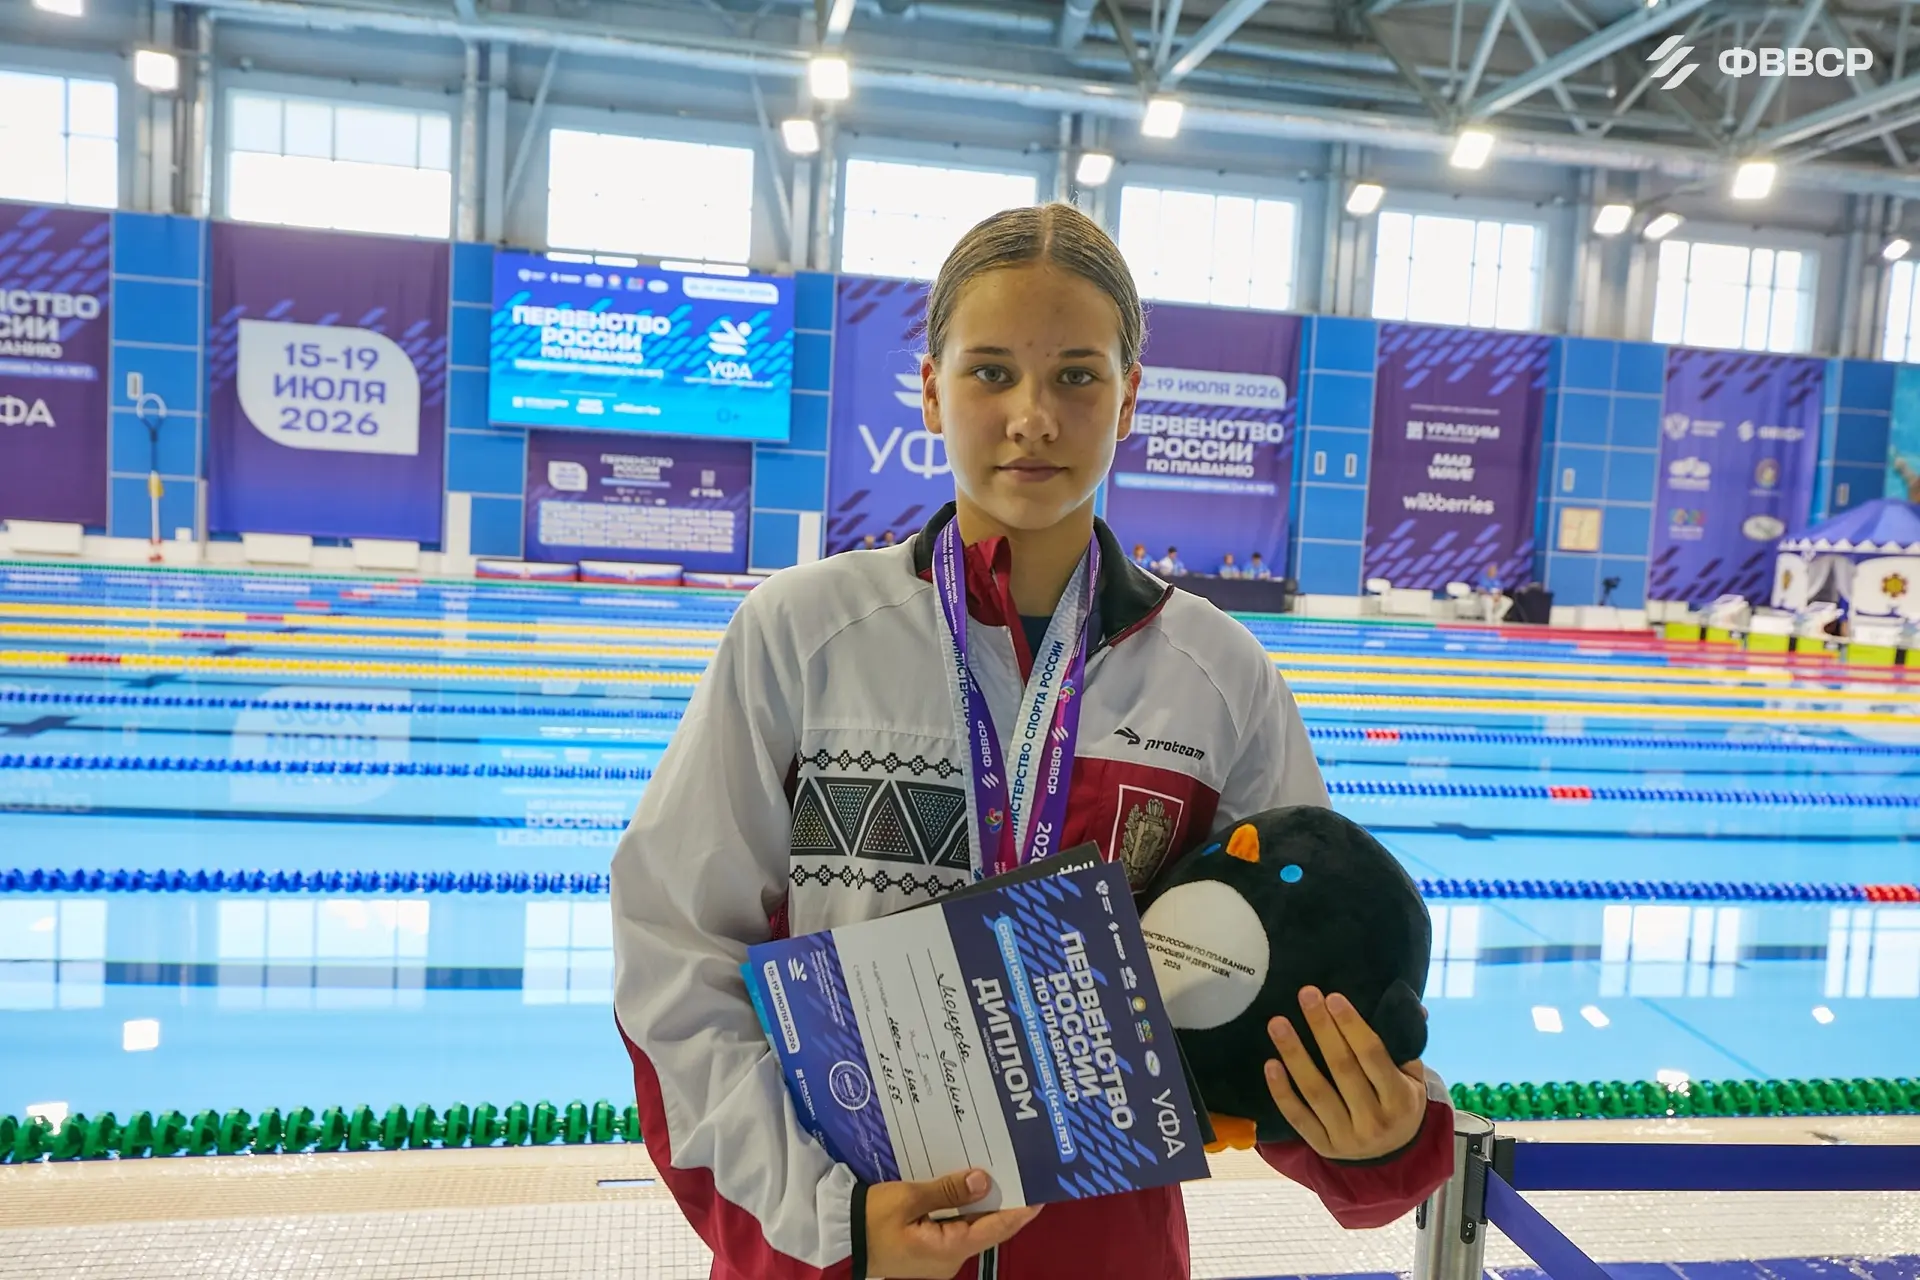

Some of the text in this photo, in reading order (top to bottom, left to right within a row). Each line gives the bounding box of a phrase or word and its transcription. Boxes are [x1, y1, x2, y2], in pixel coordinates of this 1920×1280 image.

[0, 288, 100, 319] СТВО
[512, 305, 671, 336] ПЕРВЕНСТВО
[541, 327, 643, 352] РОССИИ
[284, 342, 380, 372] 15-19
[707, 360, 753, 380] УФА
[274, 373, 386, 405] ИЮЛЯ
[1178, 379, 1231, 395] ИЮЛЯ
[1235, 384, 1281, 399] 2026
[279, 408, 380, 437] 2026
[858, 424, 952, 479] УФ
[1147, 436, 1254, 463] РОССИИ
[1146, 458, 1255, 478] ПО ПЛАВАНИЮ
[1023, 690, 1048, 739] СПОРТА
[1039, 639, 1064, 688] РОССИИ
[976, 719, 992, 767] ФВВСР
[1144, 737, 1206, 761] proteam
[1046, 746, 1063, 794] ФВВСР
[1163, 958, 1181, 970] 2026
[1190, 957, 1231, 978] ДЕВУШЕК
[1193, 946, 1205, 956] ПО
[1204, 951, 1256, 975] ПЛАВАНИЮ
[766, 965, 797, 1050] 15-19 ИЮЛЯ 2026
[936, 972, 973, 1064] Морозова
[997, 922, 1073, 1156] СРЕДИ ЮНОШЕЙ И ДЕВУШЕК (14-15 ЛЕТ)
[1032, 976, 1079, 1103] ПО ПЛАВАНИЮ
[1047, 970, 1101, 1098] РОССИИ
[1059, 929, 1135, 1131] ПЕРВЕНСТВО
[971, 972, 1038, 1124] ДИПЛОМ
[939, 1049, 964, 1124] Мария
[1148, 1088, 1188, 1159] УФА
